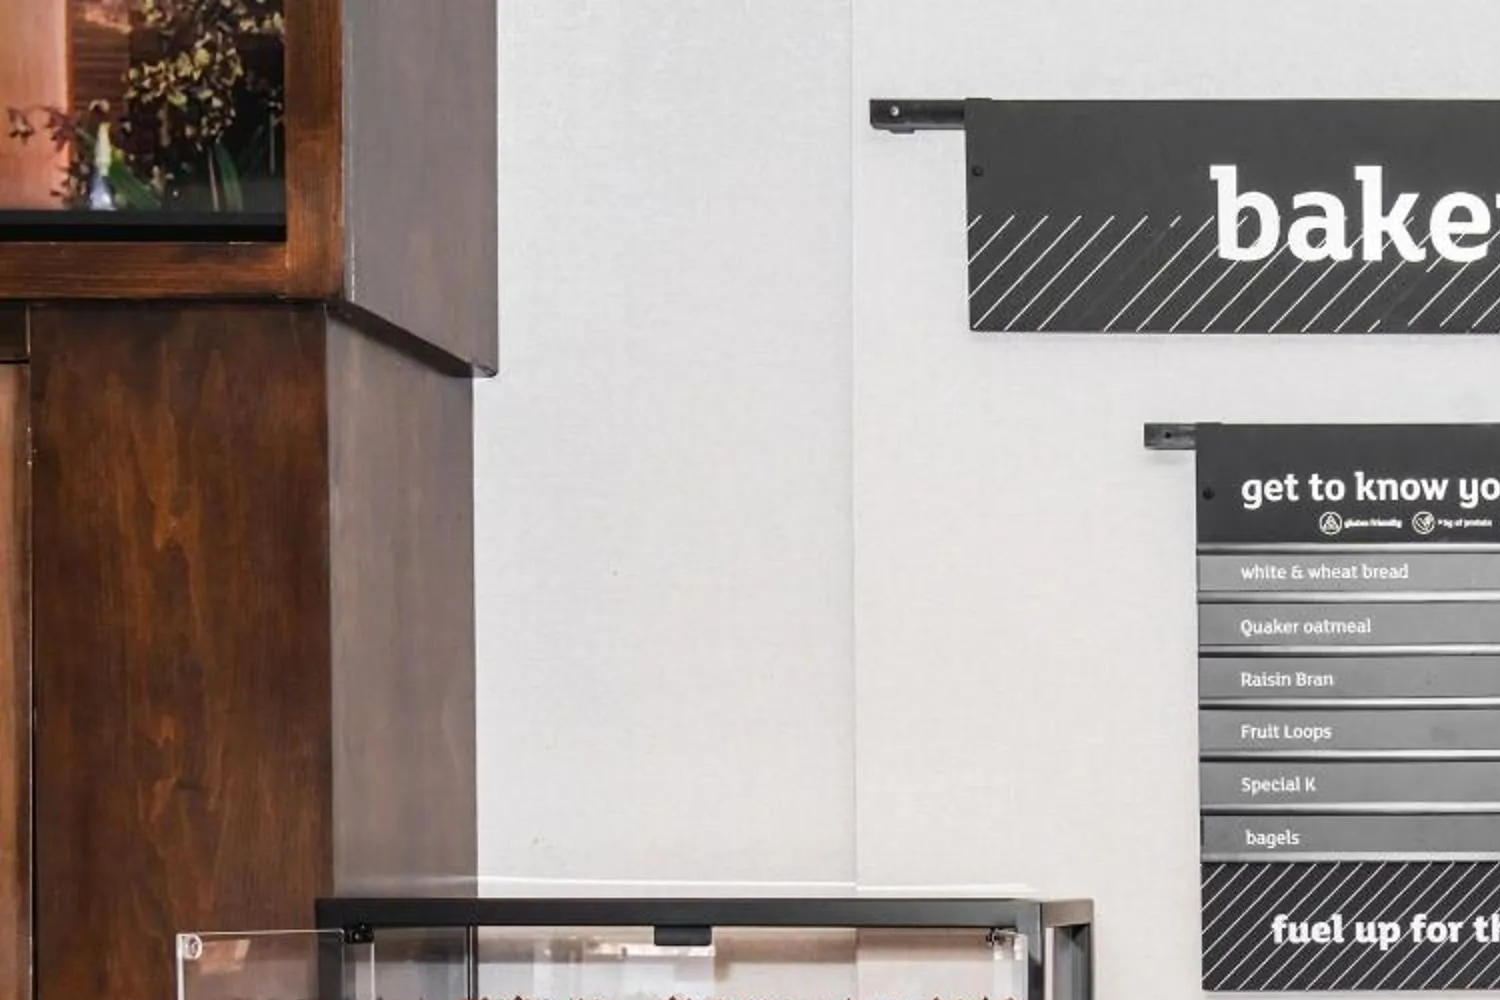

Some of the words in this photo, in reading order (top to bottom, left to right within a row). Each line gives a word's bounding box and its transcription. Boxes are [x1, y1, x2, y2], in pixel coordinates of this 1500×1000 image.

[1241, 473, 1299, 510] get
[1308, 473, 1345, 501] to
[1354, 471, 1449, 501] know
[1241, 563, 1287, 580] white
[1291, 565, 1303, 580] &
[1308, 563, 1359, 580] wheat
[1361, 563, 1409, 580] bread
[1240, 618, 1298, 637] Quaker
[1303, 617, 1372, 634] oatmeal
[1241, 671, 1292, 688] Raisin
[1295, 671, 1334, 688] Bran
[1241, 723, 1280, 740] Fruit
[1284, 724, 1333, 743] Loops
[1241, 776, 1300, 796] Special
[1304, 776, 1317, 793] K
[1245, 829, 1300, 849] bagels
[1272, 913, 1345, 944] fuel
[1355, 921, 1401, 951] up
[1410, 913, 1464, 943] for
